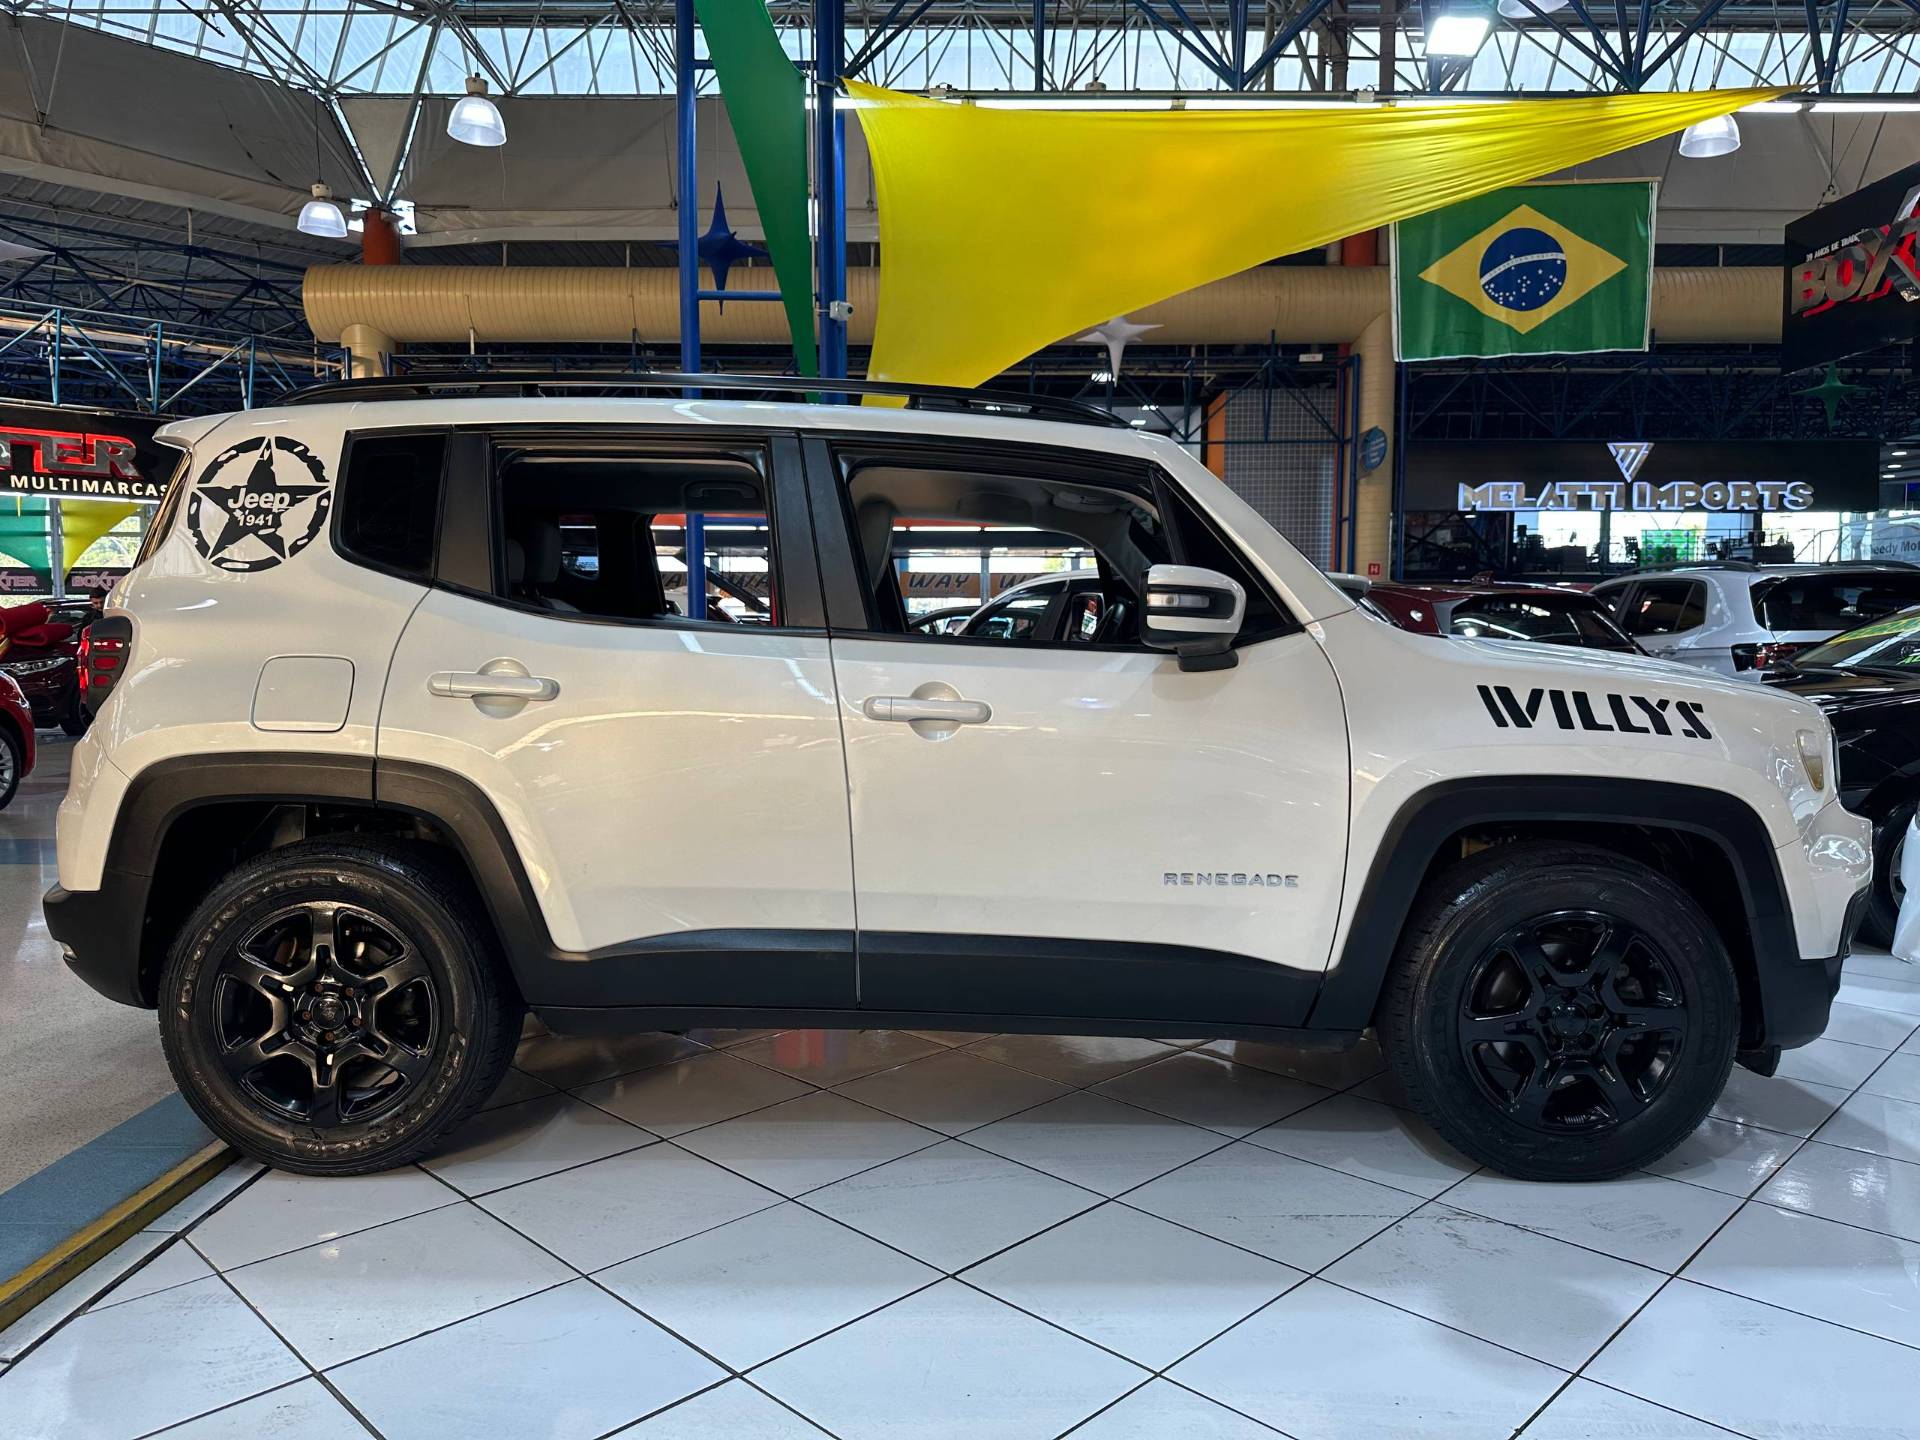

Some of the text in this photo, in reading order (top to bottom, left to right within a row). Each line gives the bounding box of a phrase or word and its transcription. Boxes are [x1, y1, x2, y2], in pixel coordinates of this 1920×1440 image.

[1792, 183, 1920, 317] BOX
[1814, 245, 1830, 258] ANOS
[1831, 240, 1840, 251] DE
[0, 426, 143, 480] TER
[227, 487, 291, 513] Jeep
[1458, 481, 1814, 512] MELATTI IMPORTS
[239, 513, 274, 527] 1941
[1870, 542, 1898, 557] eedy
[908, 573, 970, 588] WAY
[1476, 684, 1713, 740] WILLYS
[1163, 872, 1299, 888] RENEGADE
